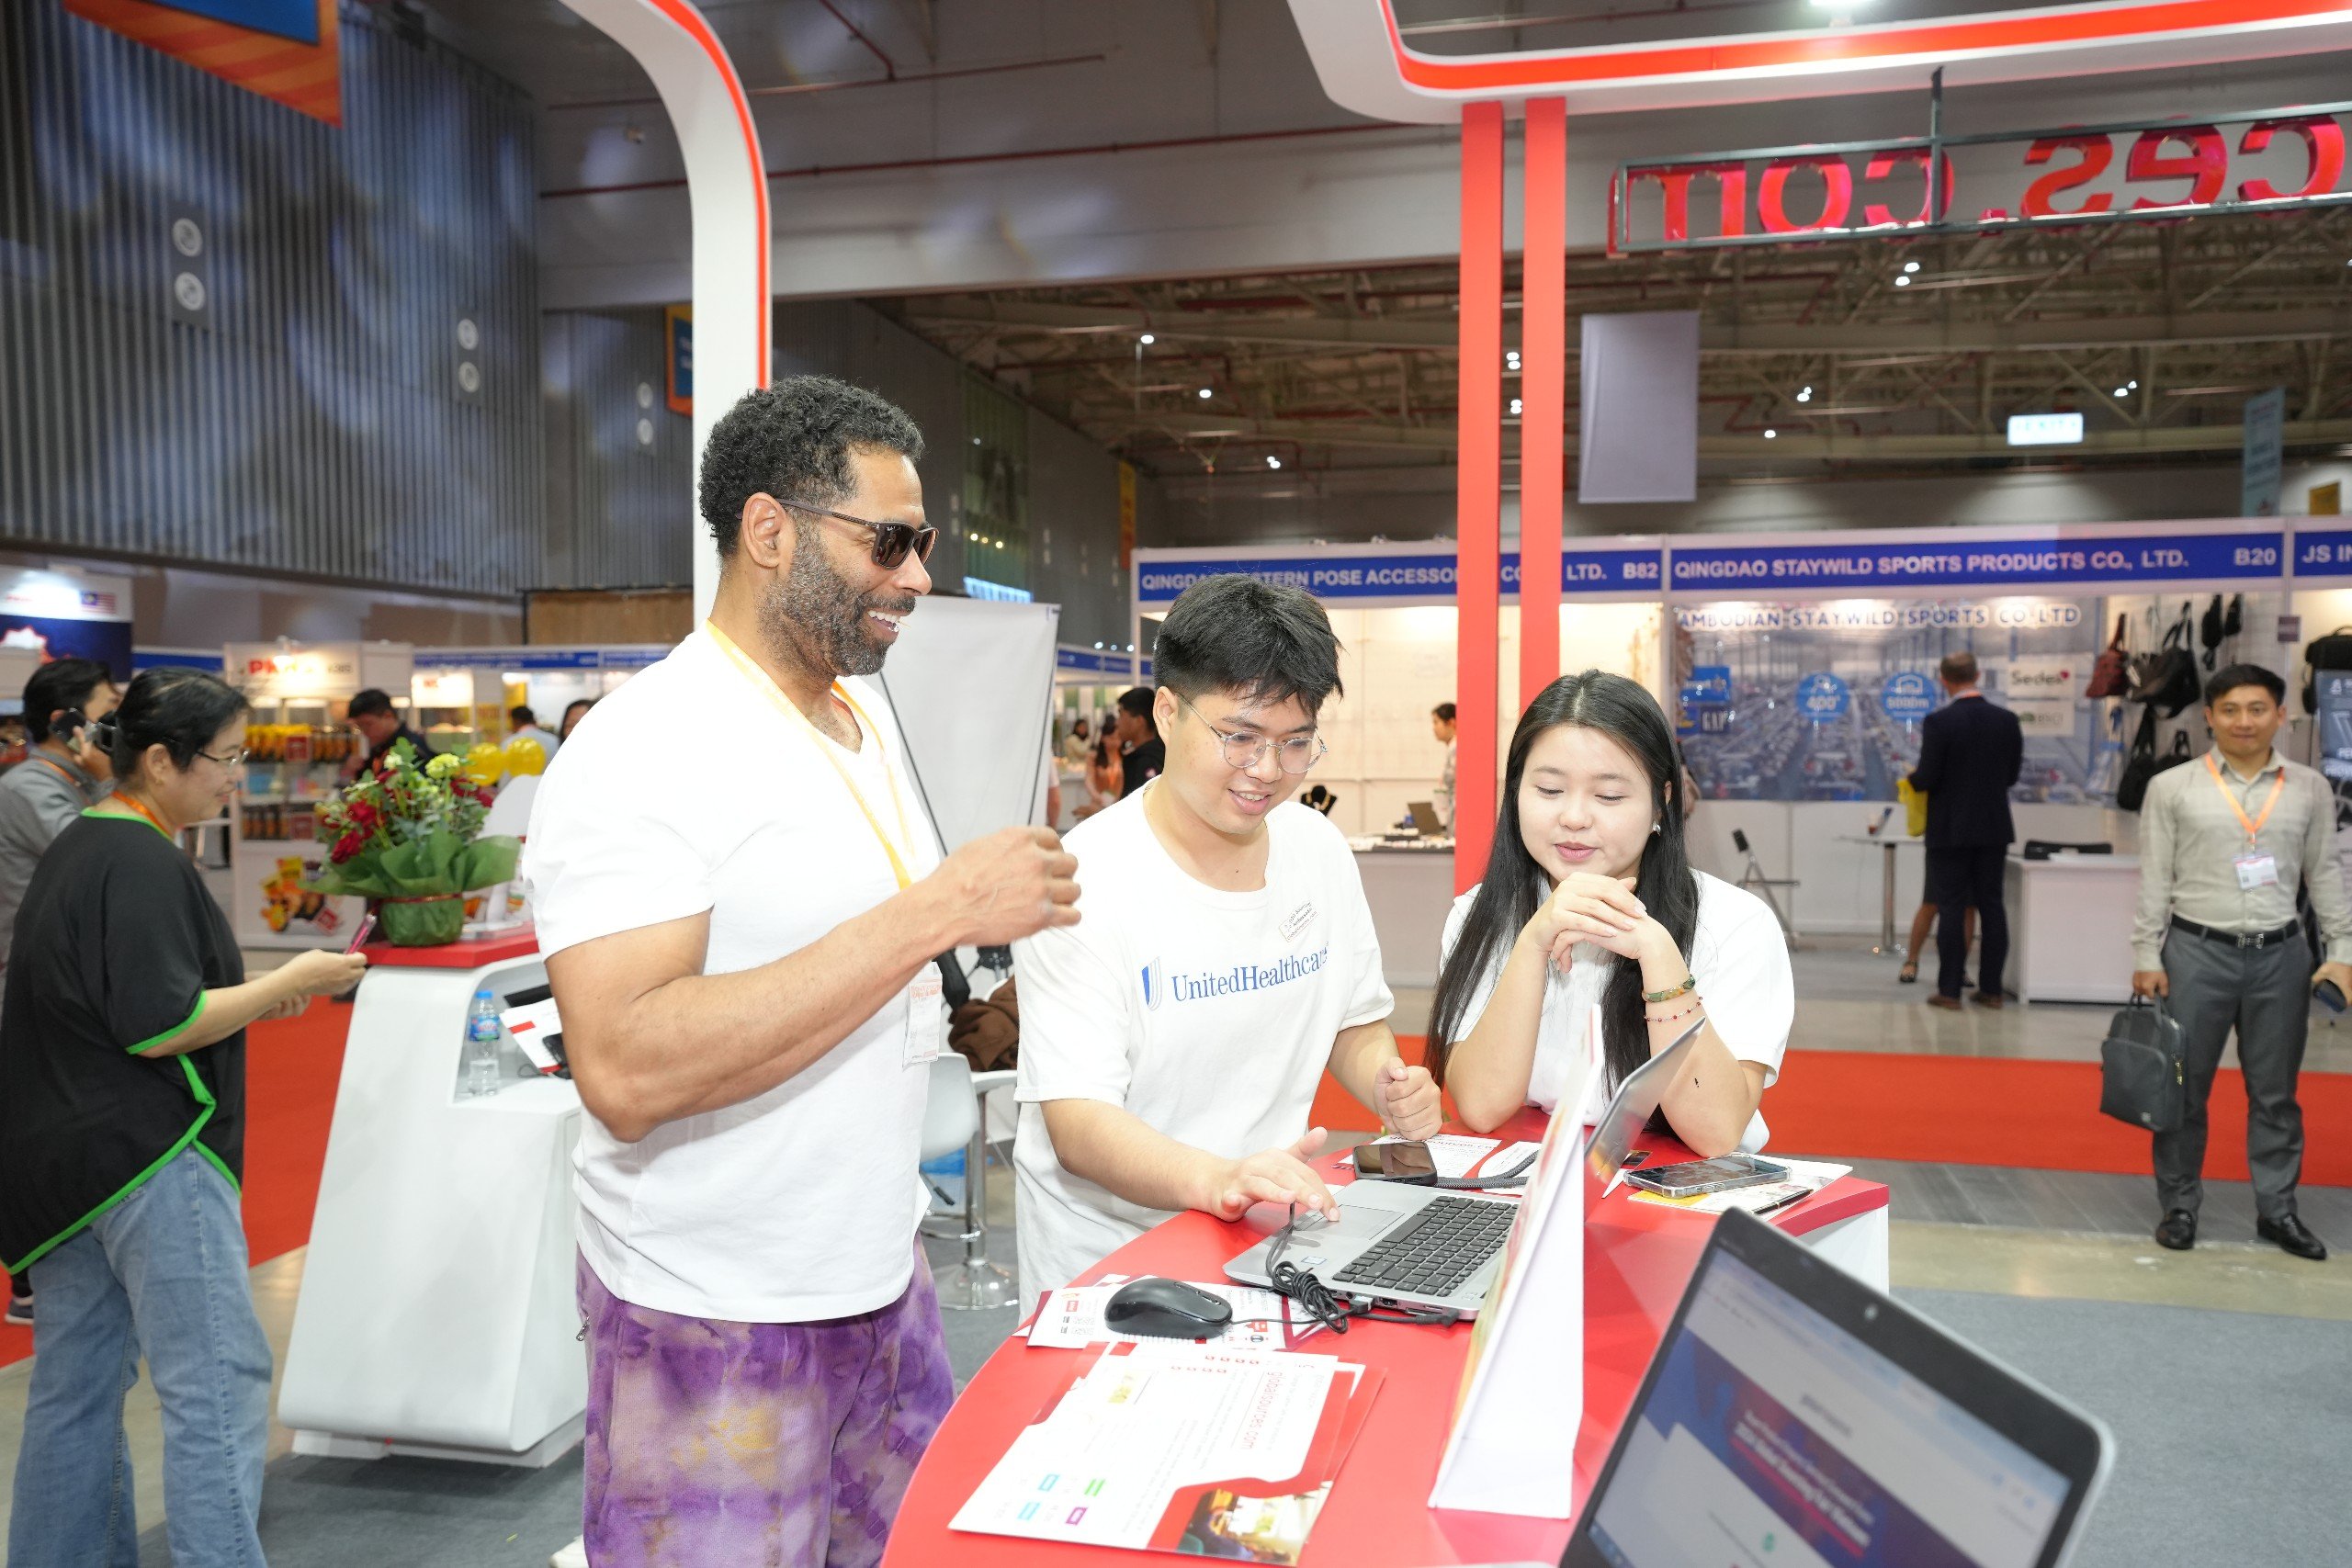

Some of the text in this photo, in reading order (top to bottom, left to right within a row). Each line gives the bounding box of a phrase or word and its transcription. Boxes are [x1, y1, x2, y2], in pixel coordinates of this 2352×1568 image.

[1674, 546, 2278, 580] QINGDAO STAYWILD SPORTS PRODUCTS CO., LTD. B20
[2301, 544, 2333, 564] JS
[1142, 574, 1200, 591] QINGD
[1313, 569, 1363, 586] POSE
[1566, 563, 1608, 581] LTD.
[1623, 561, 1659, 581] B82
[1792, 611, 1894, 626] STAYWILD
[1907, 609, 1985, 626] SPORTS
[2039, 608, 2078, 623] LTD
